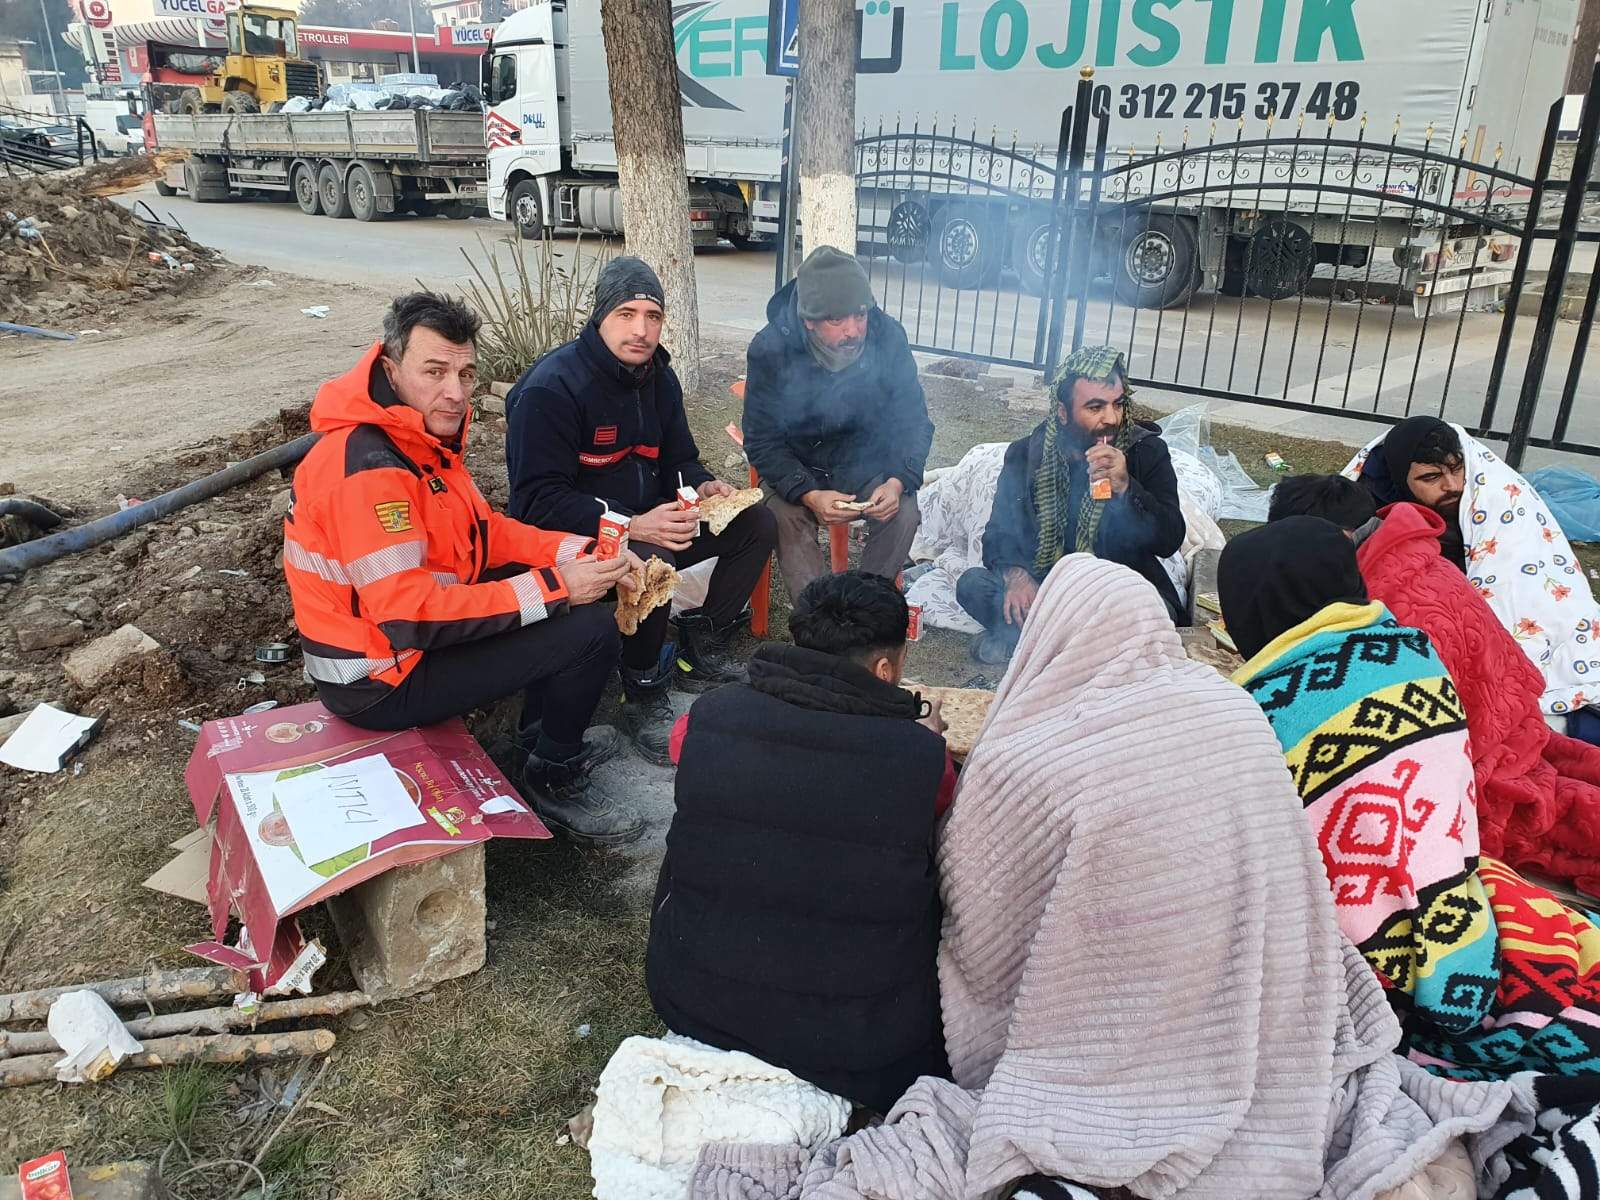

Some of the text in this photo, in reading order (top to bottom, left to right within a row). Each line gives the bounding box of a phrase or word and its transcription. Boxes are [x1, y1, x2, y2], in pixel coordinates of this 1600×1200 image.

[1091, 80, 1361, 121] 0 312 215 37 48
